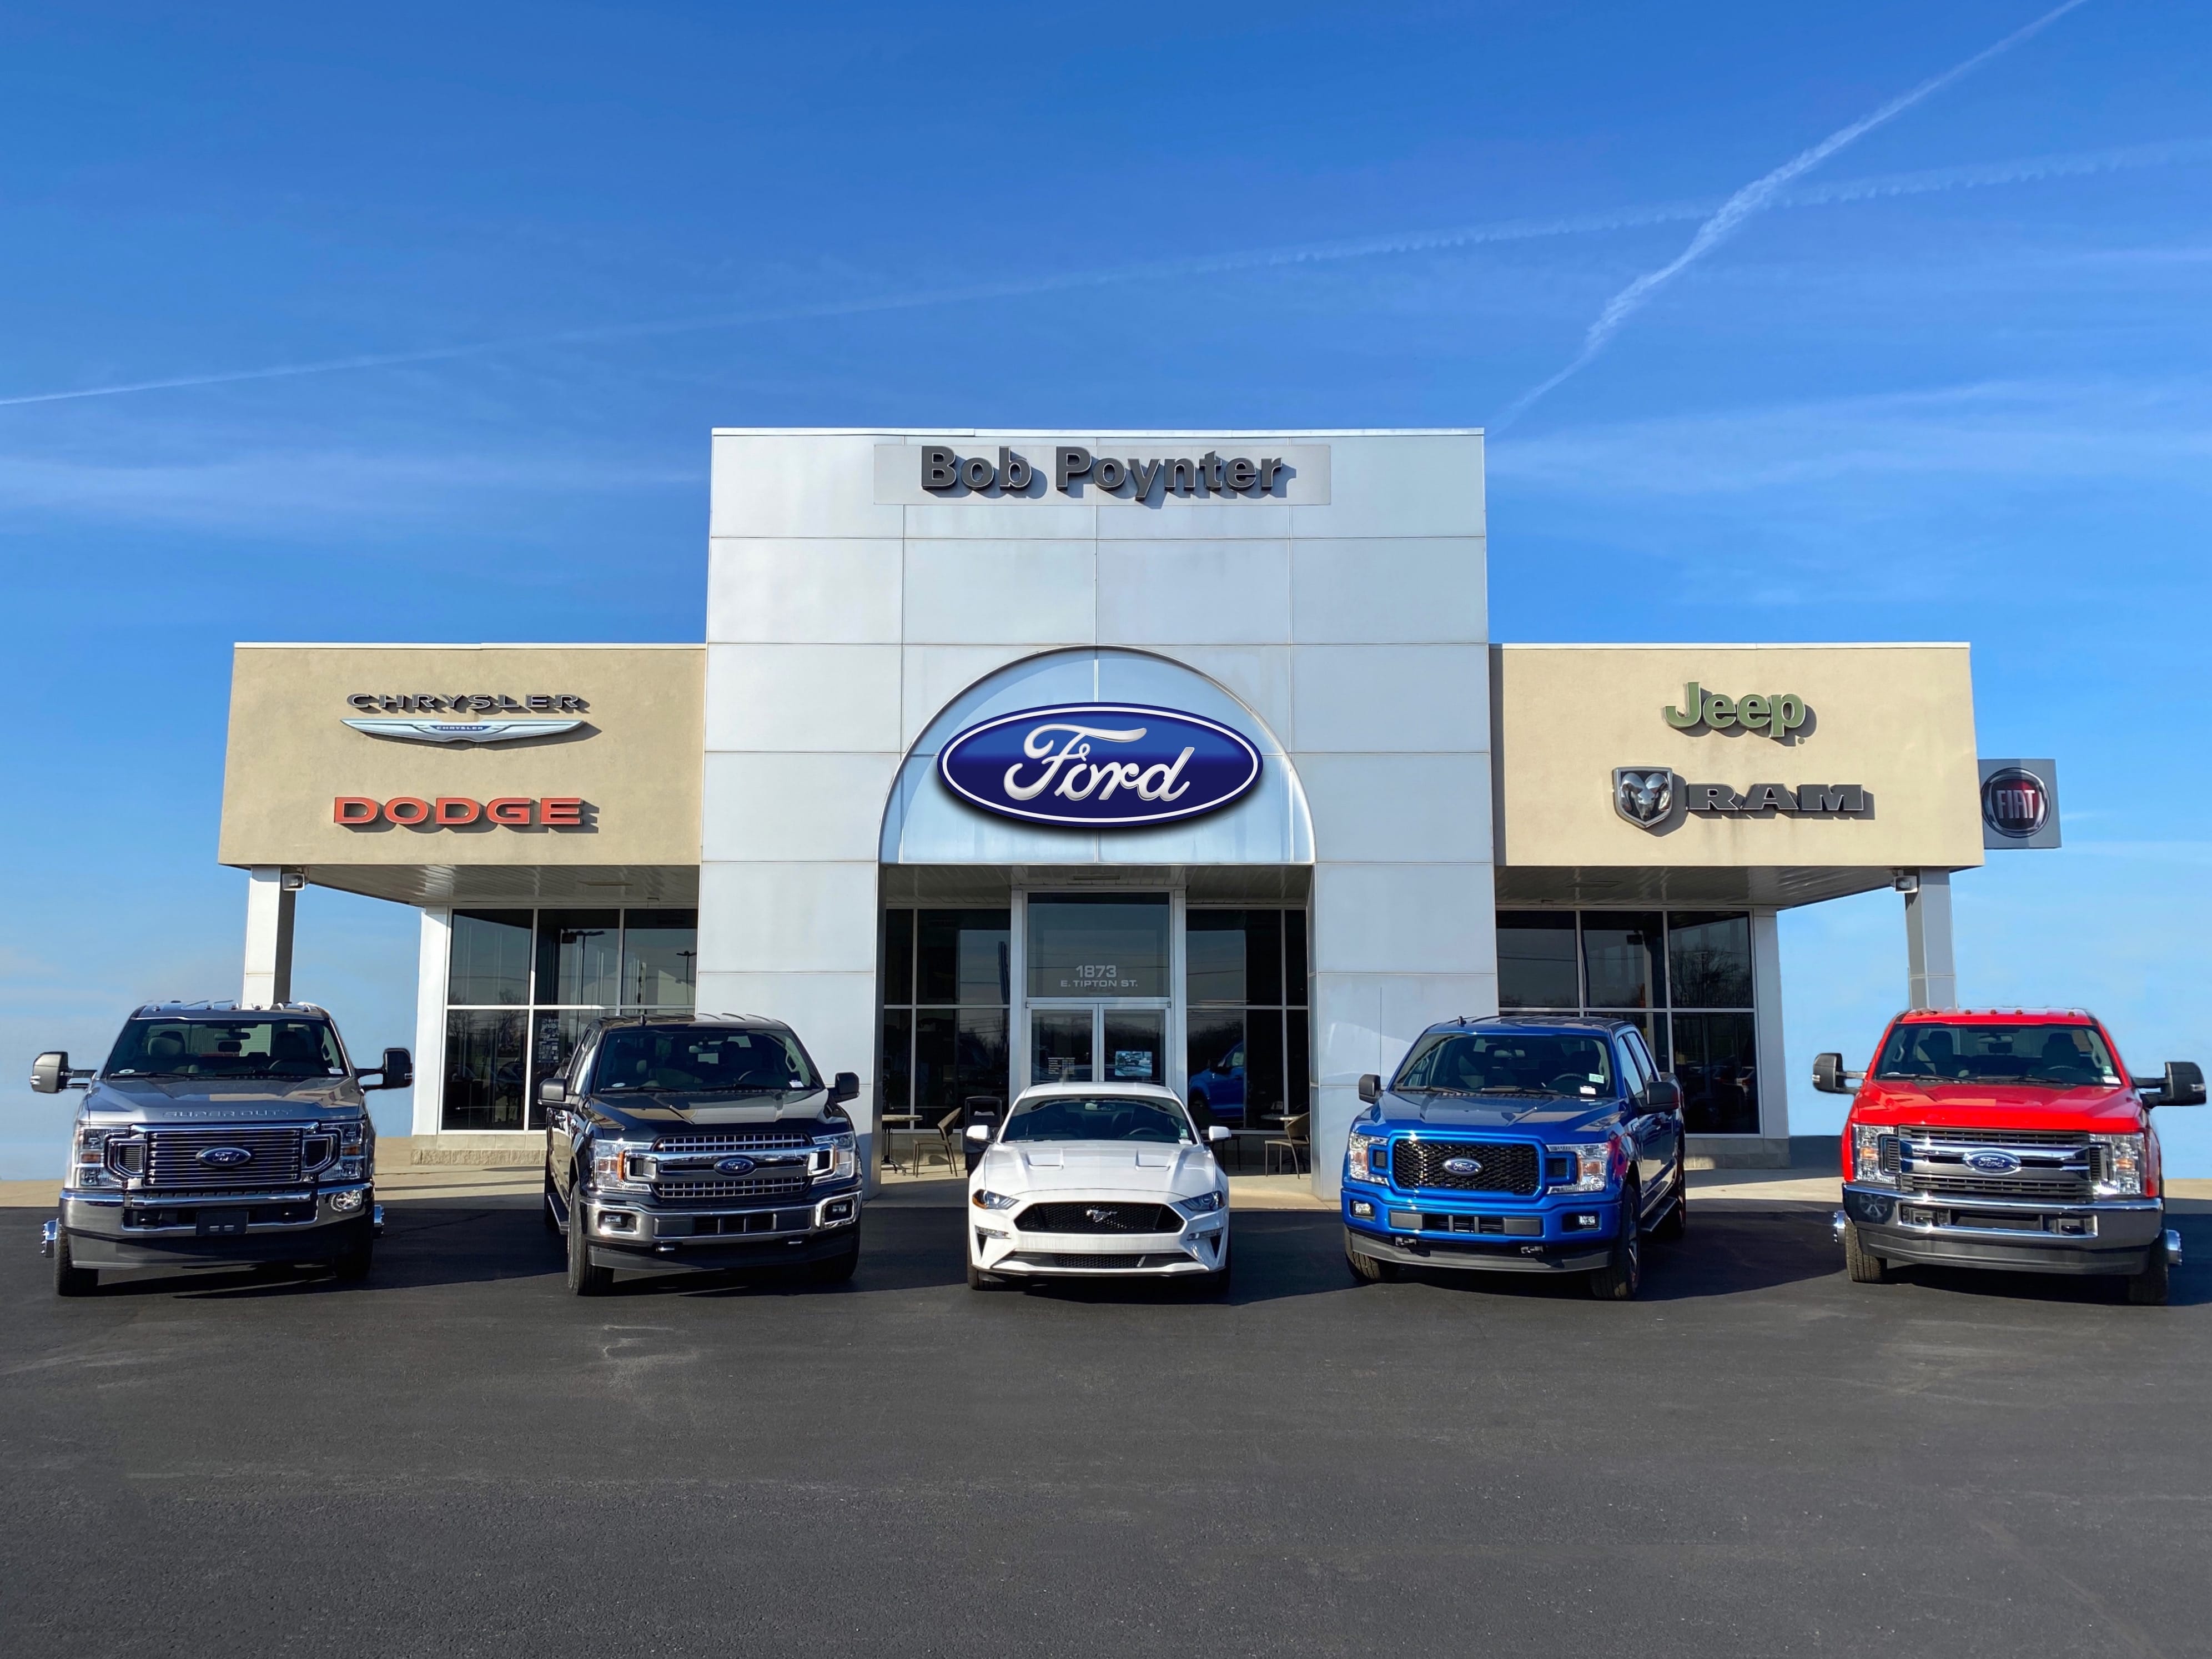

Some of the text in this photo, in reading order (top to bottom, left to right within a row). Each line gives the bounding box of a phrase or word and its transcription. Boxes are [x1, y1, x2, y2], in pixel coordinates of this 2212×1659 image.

[921, 445, 1283, 501] Bob Poynter
[346, 693, 580, 710] CHRYSLER
[1662, 681, 1806, 738] Jeep
[1003, 723, 1195, 802] Ford
[333, 796, 584, 825] DODGE
[1686, 783, 1864, 812] RAM
[1996, 789, 2036, 819] FIAT
[1075, 965, 1117, 978] 1873
[212, 1151, 240, 1162] Ford
[1453, 1162, 1473, 1171] Ford
[1978, 1156, 2005, 1168] Ford
